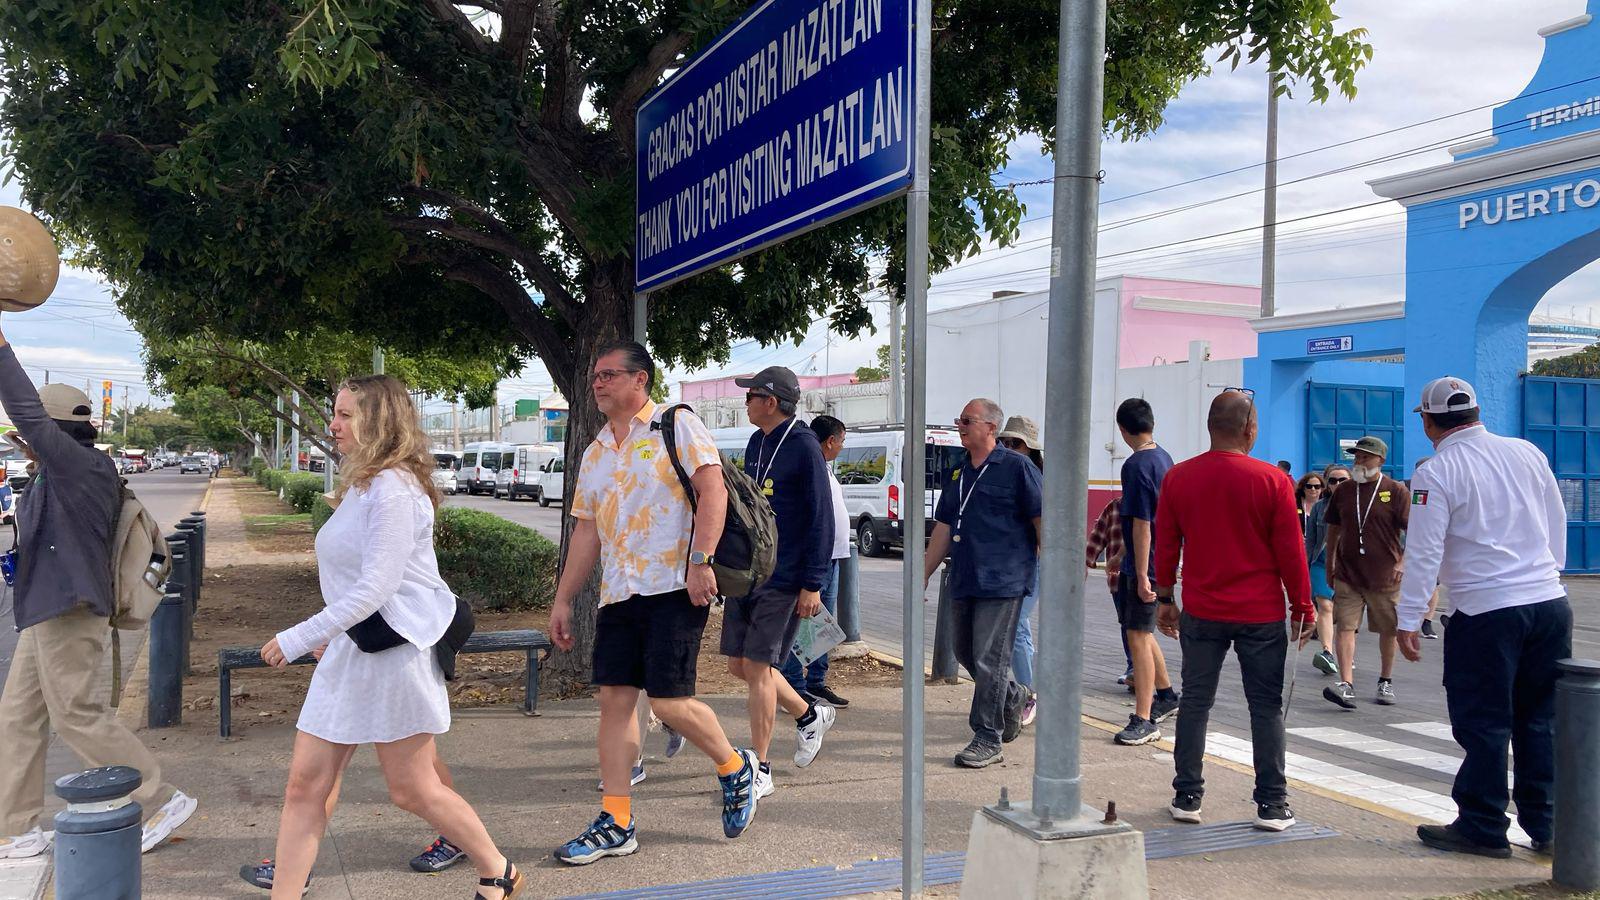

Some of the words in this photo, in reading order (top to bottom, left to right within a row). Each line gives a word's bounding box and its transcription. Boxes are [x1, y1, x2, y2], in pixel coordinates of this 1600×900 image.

[639, 197, 673, 262] THANK
[676, 182, 701, 244] YOU
[702, 168, 728, 233] FOR
[729, 130, 792, 219] VISITING
[796, 66, 903, 189] MAZATLAN
[647, 108, 694, 182] GRACIAS
[697, 82, 723, 151] POR
[724, 39, 778, 131] VISITAR
[1459, 179, 1600, 229] PUERTO
